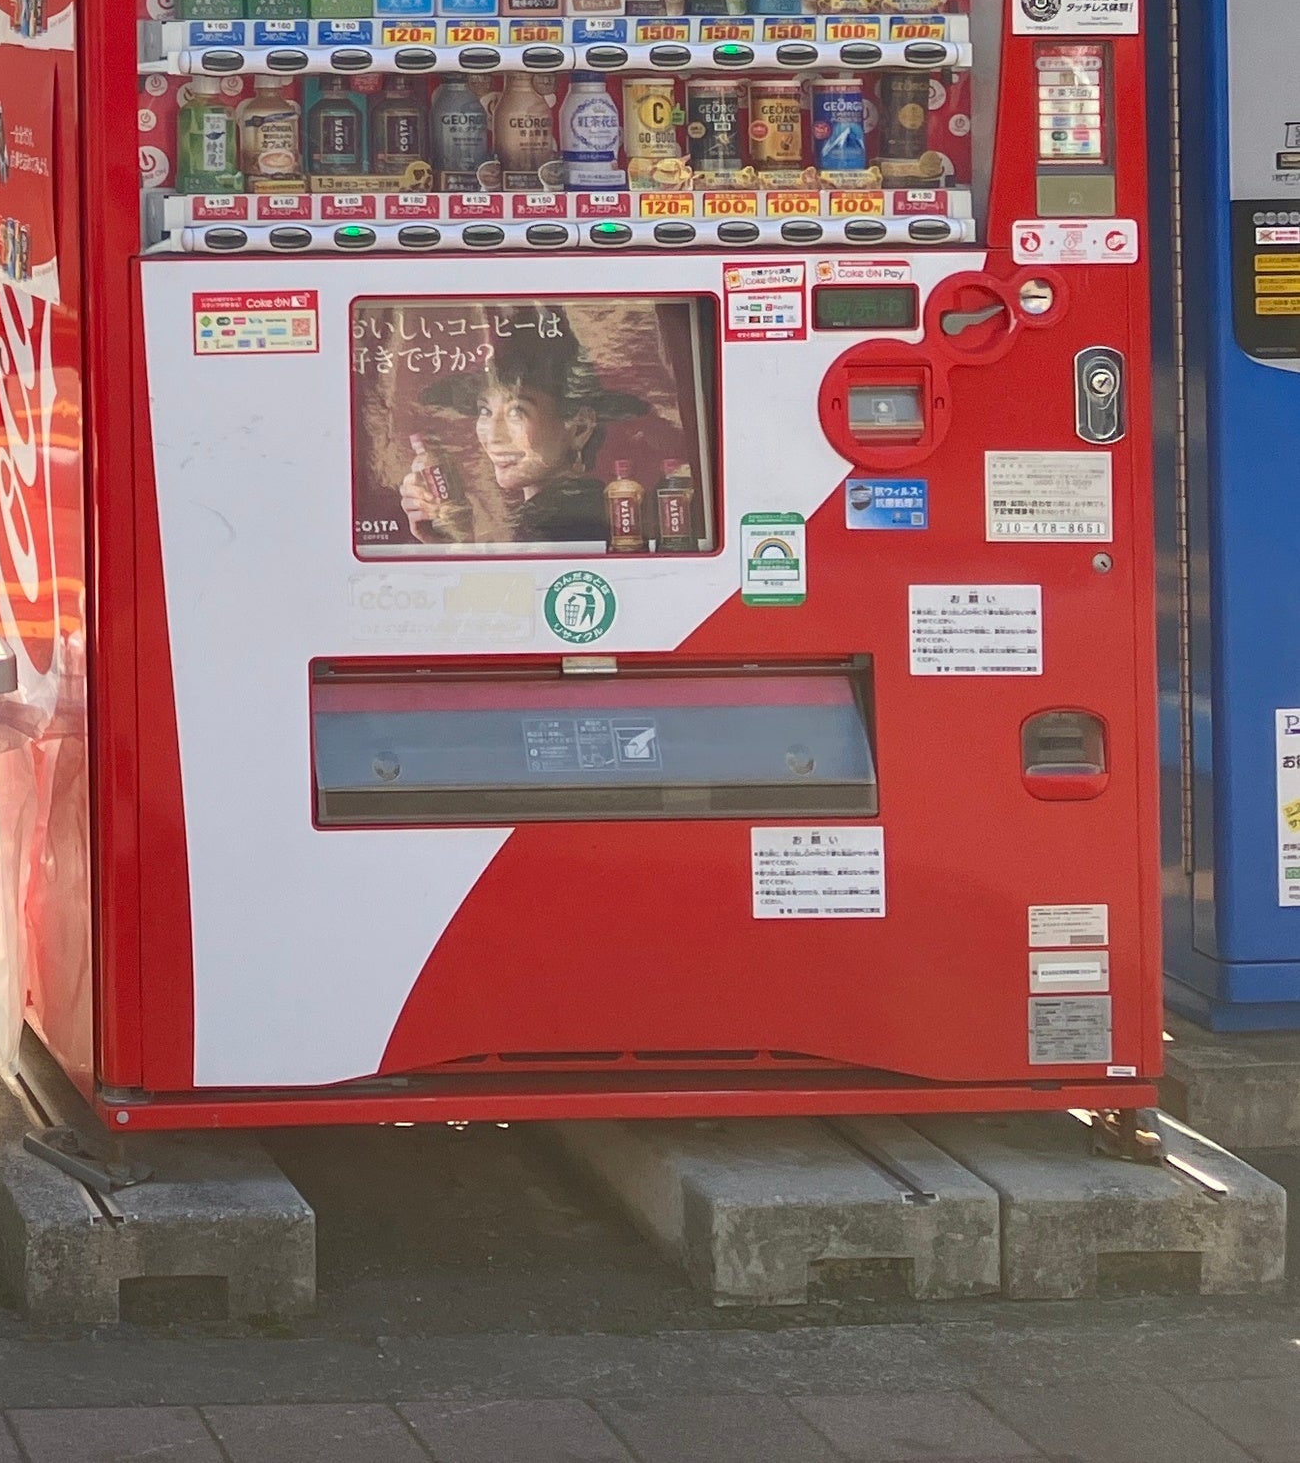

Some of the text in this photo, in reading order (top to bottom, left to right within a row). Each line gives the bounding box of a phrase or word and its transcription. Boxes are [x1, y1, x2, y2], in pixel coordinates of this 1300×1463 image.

[387, 28, 432, 42] 120円
[451, 28, 495, 42] 120円
[514, 28, 559, 41] 150円
[640, 26, 685, 40] 150円
[704, 26, 749, 39] 150円
[767, 26, 813, 39] 150円
[830, 25, 876, 38] 100円
[896, 25, 941, 38] 100円
[334, 119, 344, 152] COSTA
[399, 118, 409, 152] COSTA
[645, 201, 689, 214] 120円
[707, 200, 754, 214] 100円
[770, 199, 818, 214] 100円
[834, 199, 881, 213] 100円
[837, 270, 863, 279] Coke
[884, 269, 904, 280] Pay
[246, 298, 273, 308] Coke
[620, 499, 632, 535] COSTA
[668, 499, 680, 534] COSTA
[553, 572, 610, 595] のんだあとは
[553, 621, 604, 642] リサイクル
